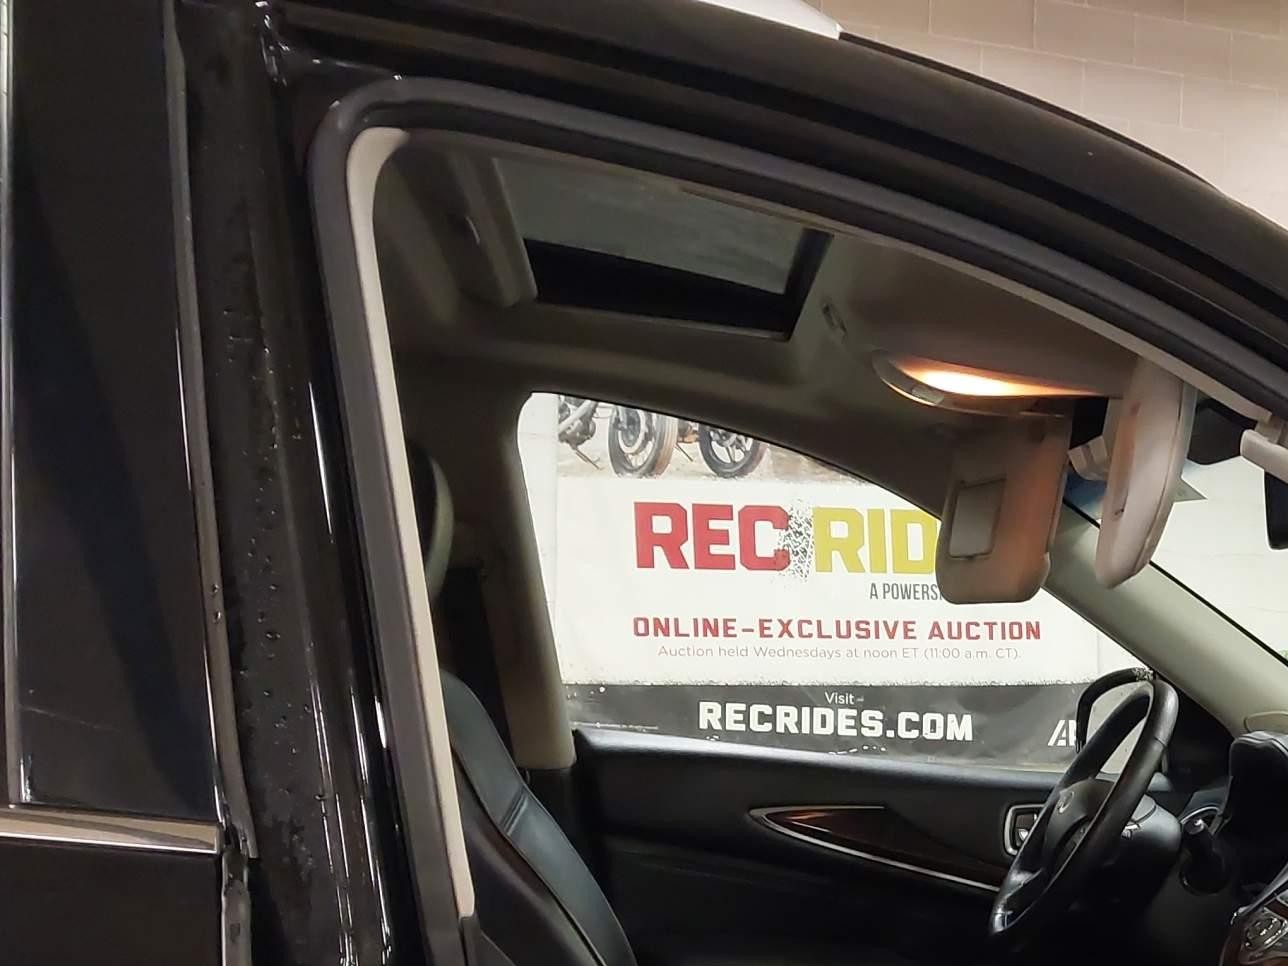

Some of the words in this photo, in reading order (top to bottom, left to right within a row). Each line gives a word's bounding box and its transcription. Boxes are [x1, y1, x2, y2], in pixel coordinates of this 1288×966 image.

[633, 501, 791, 571] REC
[869, 583, 879, 600] A
[633, 616, 917, 640] ONLINE-EXCLUSIVE
[928, 620, 1041, 641] AUCTION
[658, 645, 712, 658] Auction
[719, 645, 749, 658] held
[753, 645, 842, 660] Wednesdays
[846, 648, 860, 659] at
[864, 649, 898, 659] noon
[902, 648, 918, 659] ET
[924, 647, 960, 660] (11:00
[964, 650, 993, 660] a.m.
[996, 648, 1022, 660] CT).
[825, 691, 855, 705] Visit
[699, 701, 974, 742] RECRIDES.COM
